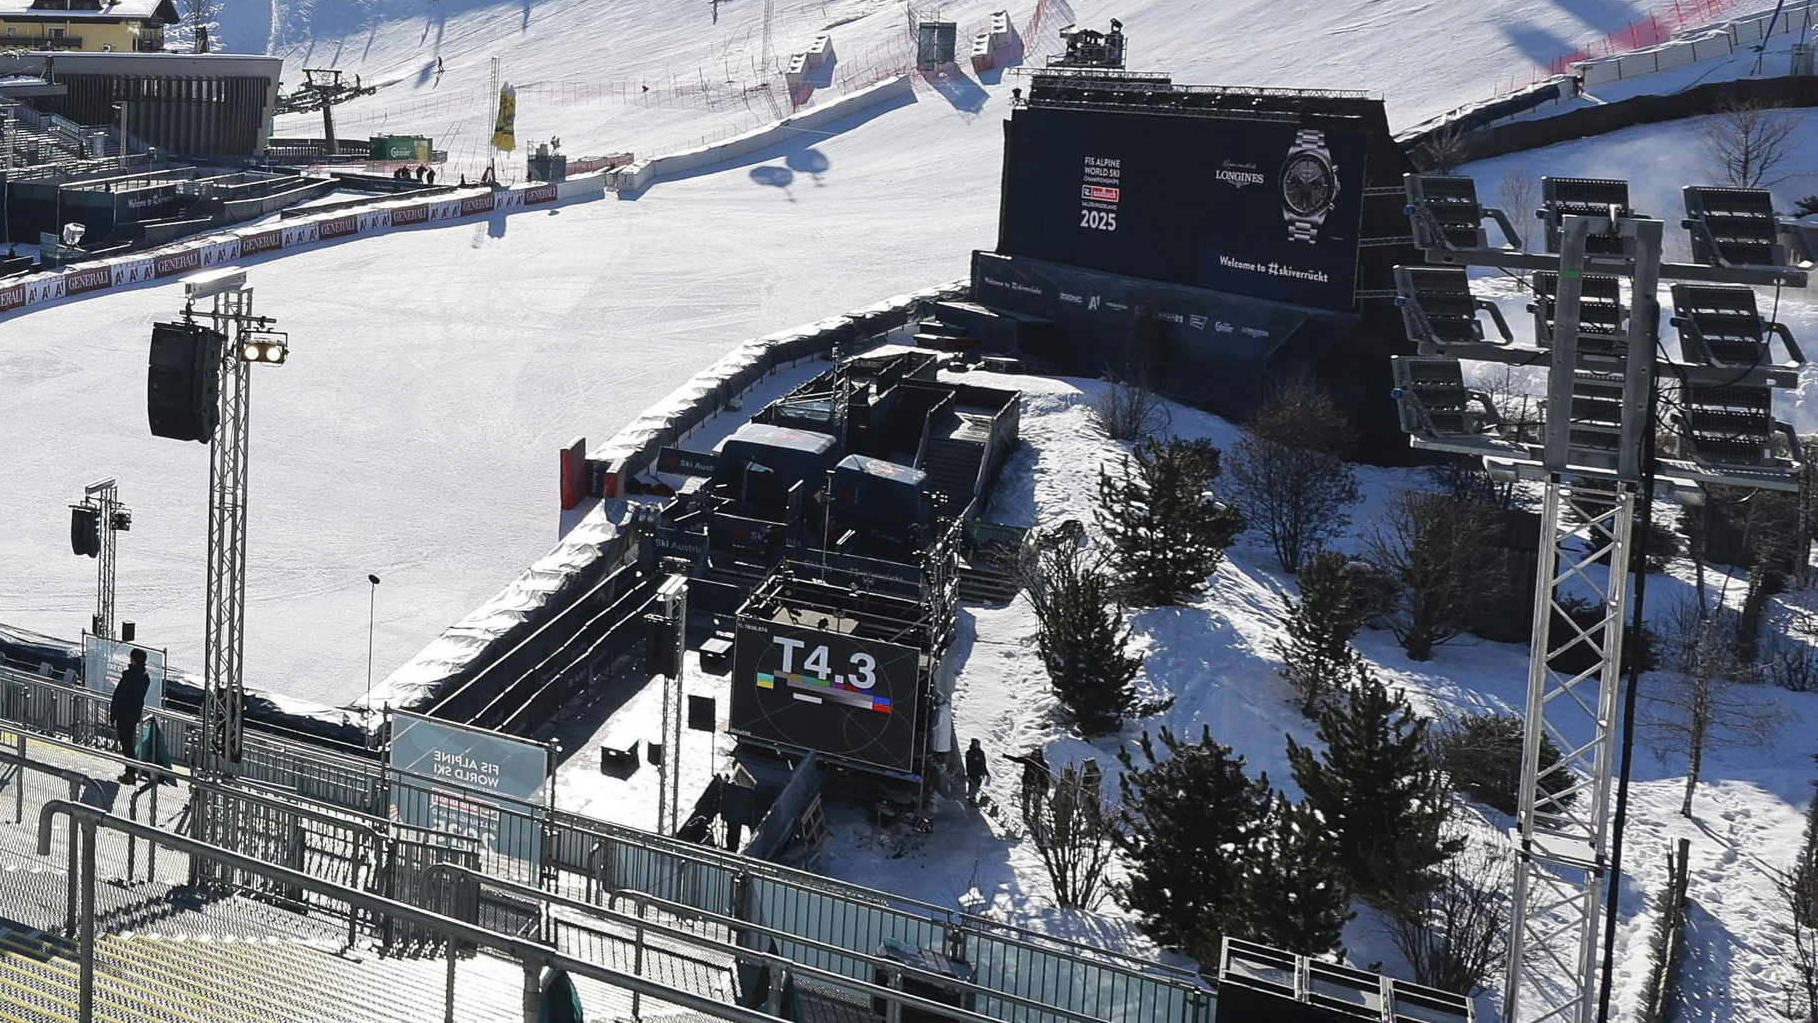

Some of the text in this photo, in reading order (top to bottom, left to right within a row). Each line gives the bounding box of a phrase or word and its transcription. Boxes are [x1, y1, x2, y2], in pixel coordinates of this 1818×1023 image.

[1084, 157, 1121, 168] FIS ALPINE
[1084, 167, 1120, 178] WORLD SKI
[1215, 169, 1264, 184] LONGINES
[322, 219, 355, 235] GENERALI
[1080, 209, 1117, 231] 2025
[243, 233, 280, 252] GENERALI
[157, 254, 198, 274] GENERALI
[1219, 255, 1328, 283] Welcome to #skiverrückt
[68, 270, 110, 290] GENERALI
[115, 265, 154, 285] A1 A1 A1
[28, 281, 64, 304] A1 A1 A1
[1088, 295, 1101, 310] A1
[680, 459, 693, 468] Ski
[655, 538, 669, 549] Ski
[773, 635, 876, 690] T4.3
